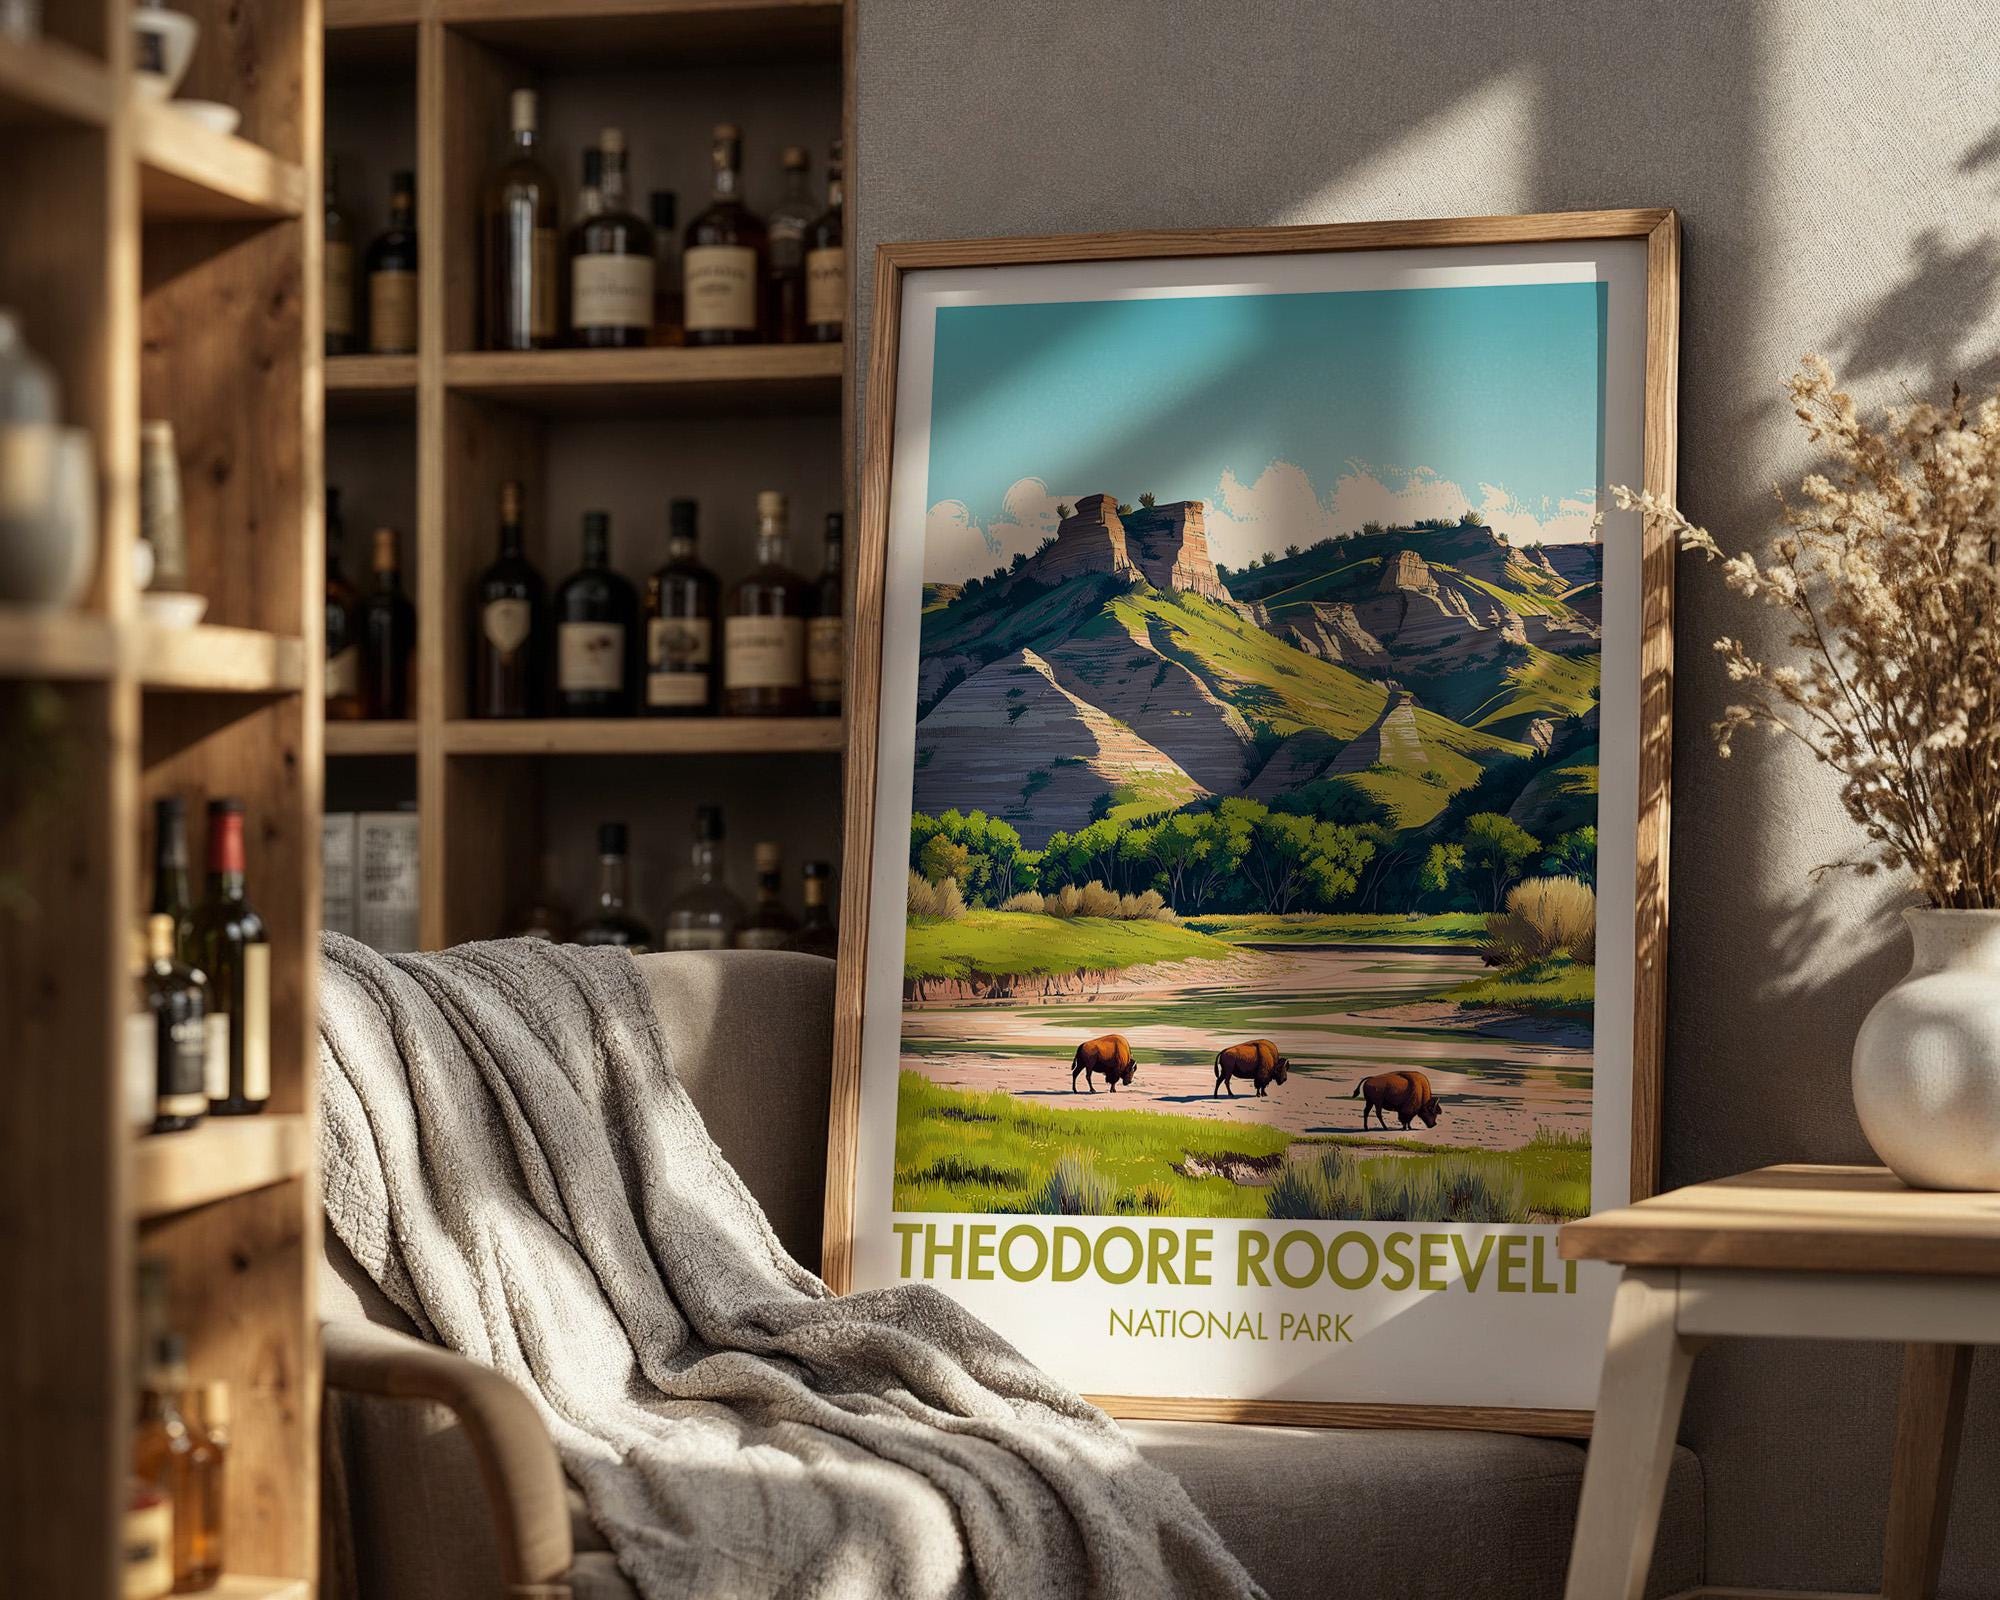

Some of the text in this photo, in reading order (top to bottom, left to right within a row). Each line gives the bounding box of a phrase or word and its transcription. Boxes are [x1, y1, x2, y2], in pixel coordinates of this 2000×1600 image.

[892, 1223, 1214, 1286] THEODORE
[1109, 1308, 1354, 1343] NATIONAL PARK
